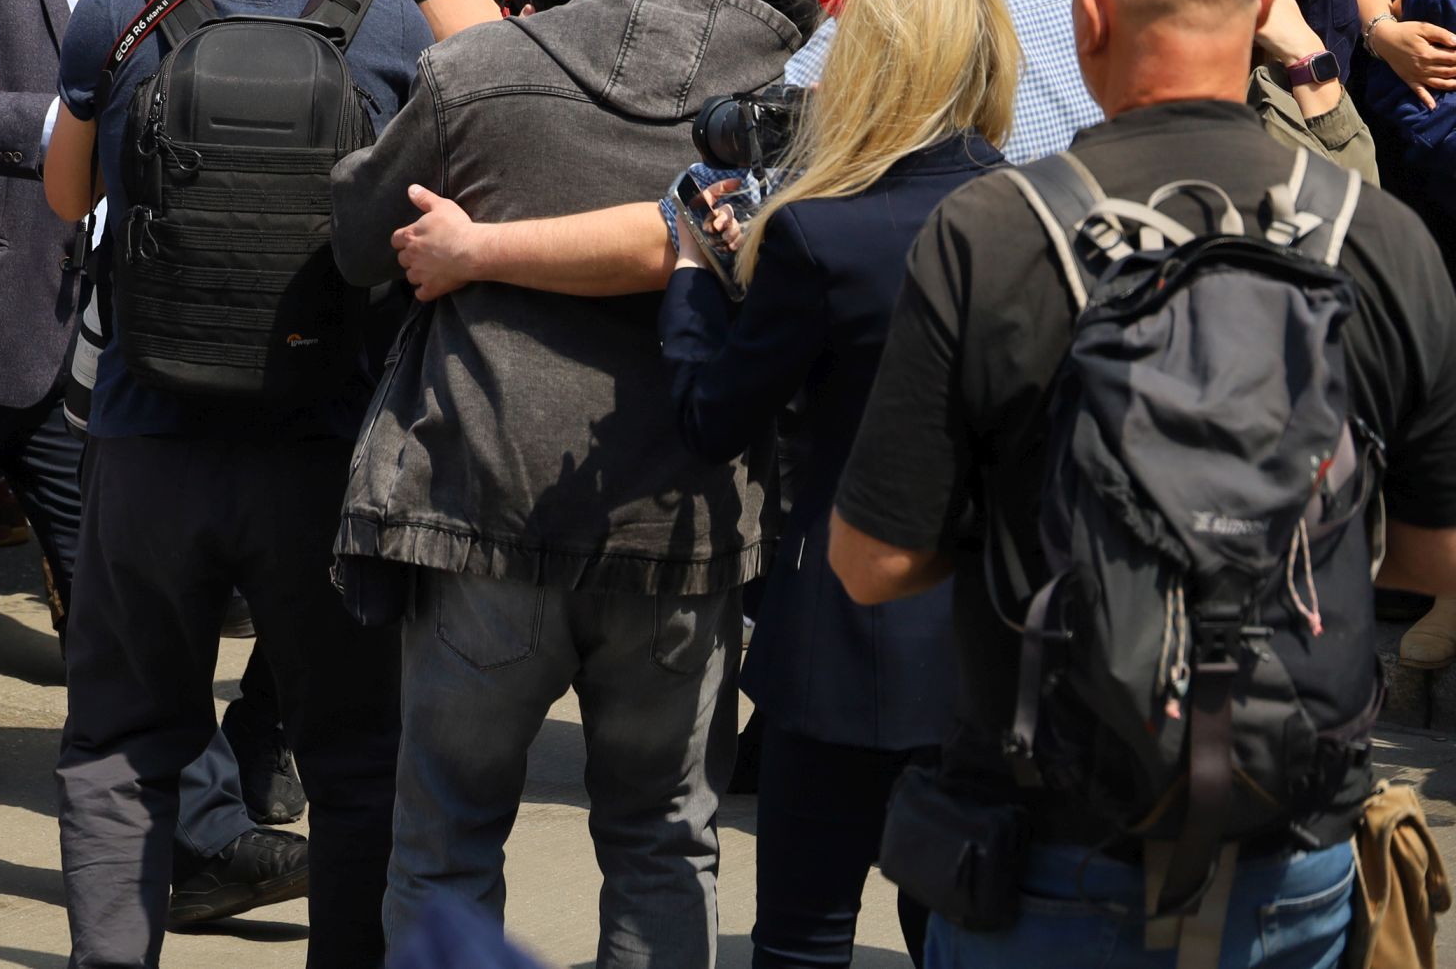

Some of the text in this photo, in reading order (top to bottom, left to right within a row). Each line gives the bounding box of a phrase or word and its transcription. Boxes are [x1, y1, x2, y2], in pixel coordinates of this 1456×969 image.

[115, 33, 135, 62] EOS
[132, 19, 147, 37] R6
[146, 4, 165, 23] Mark
